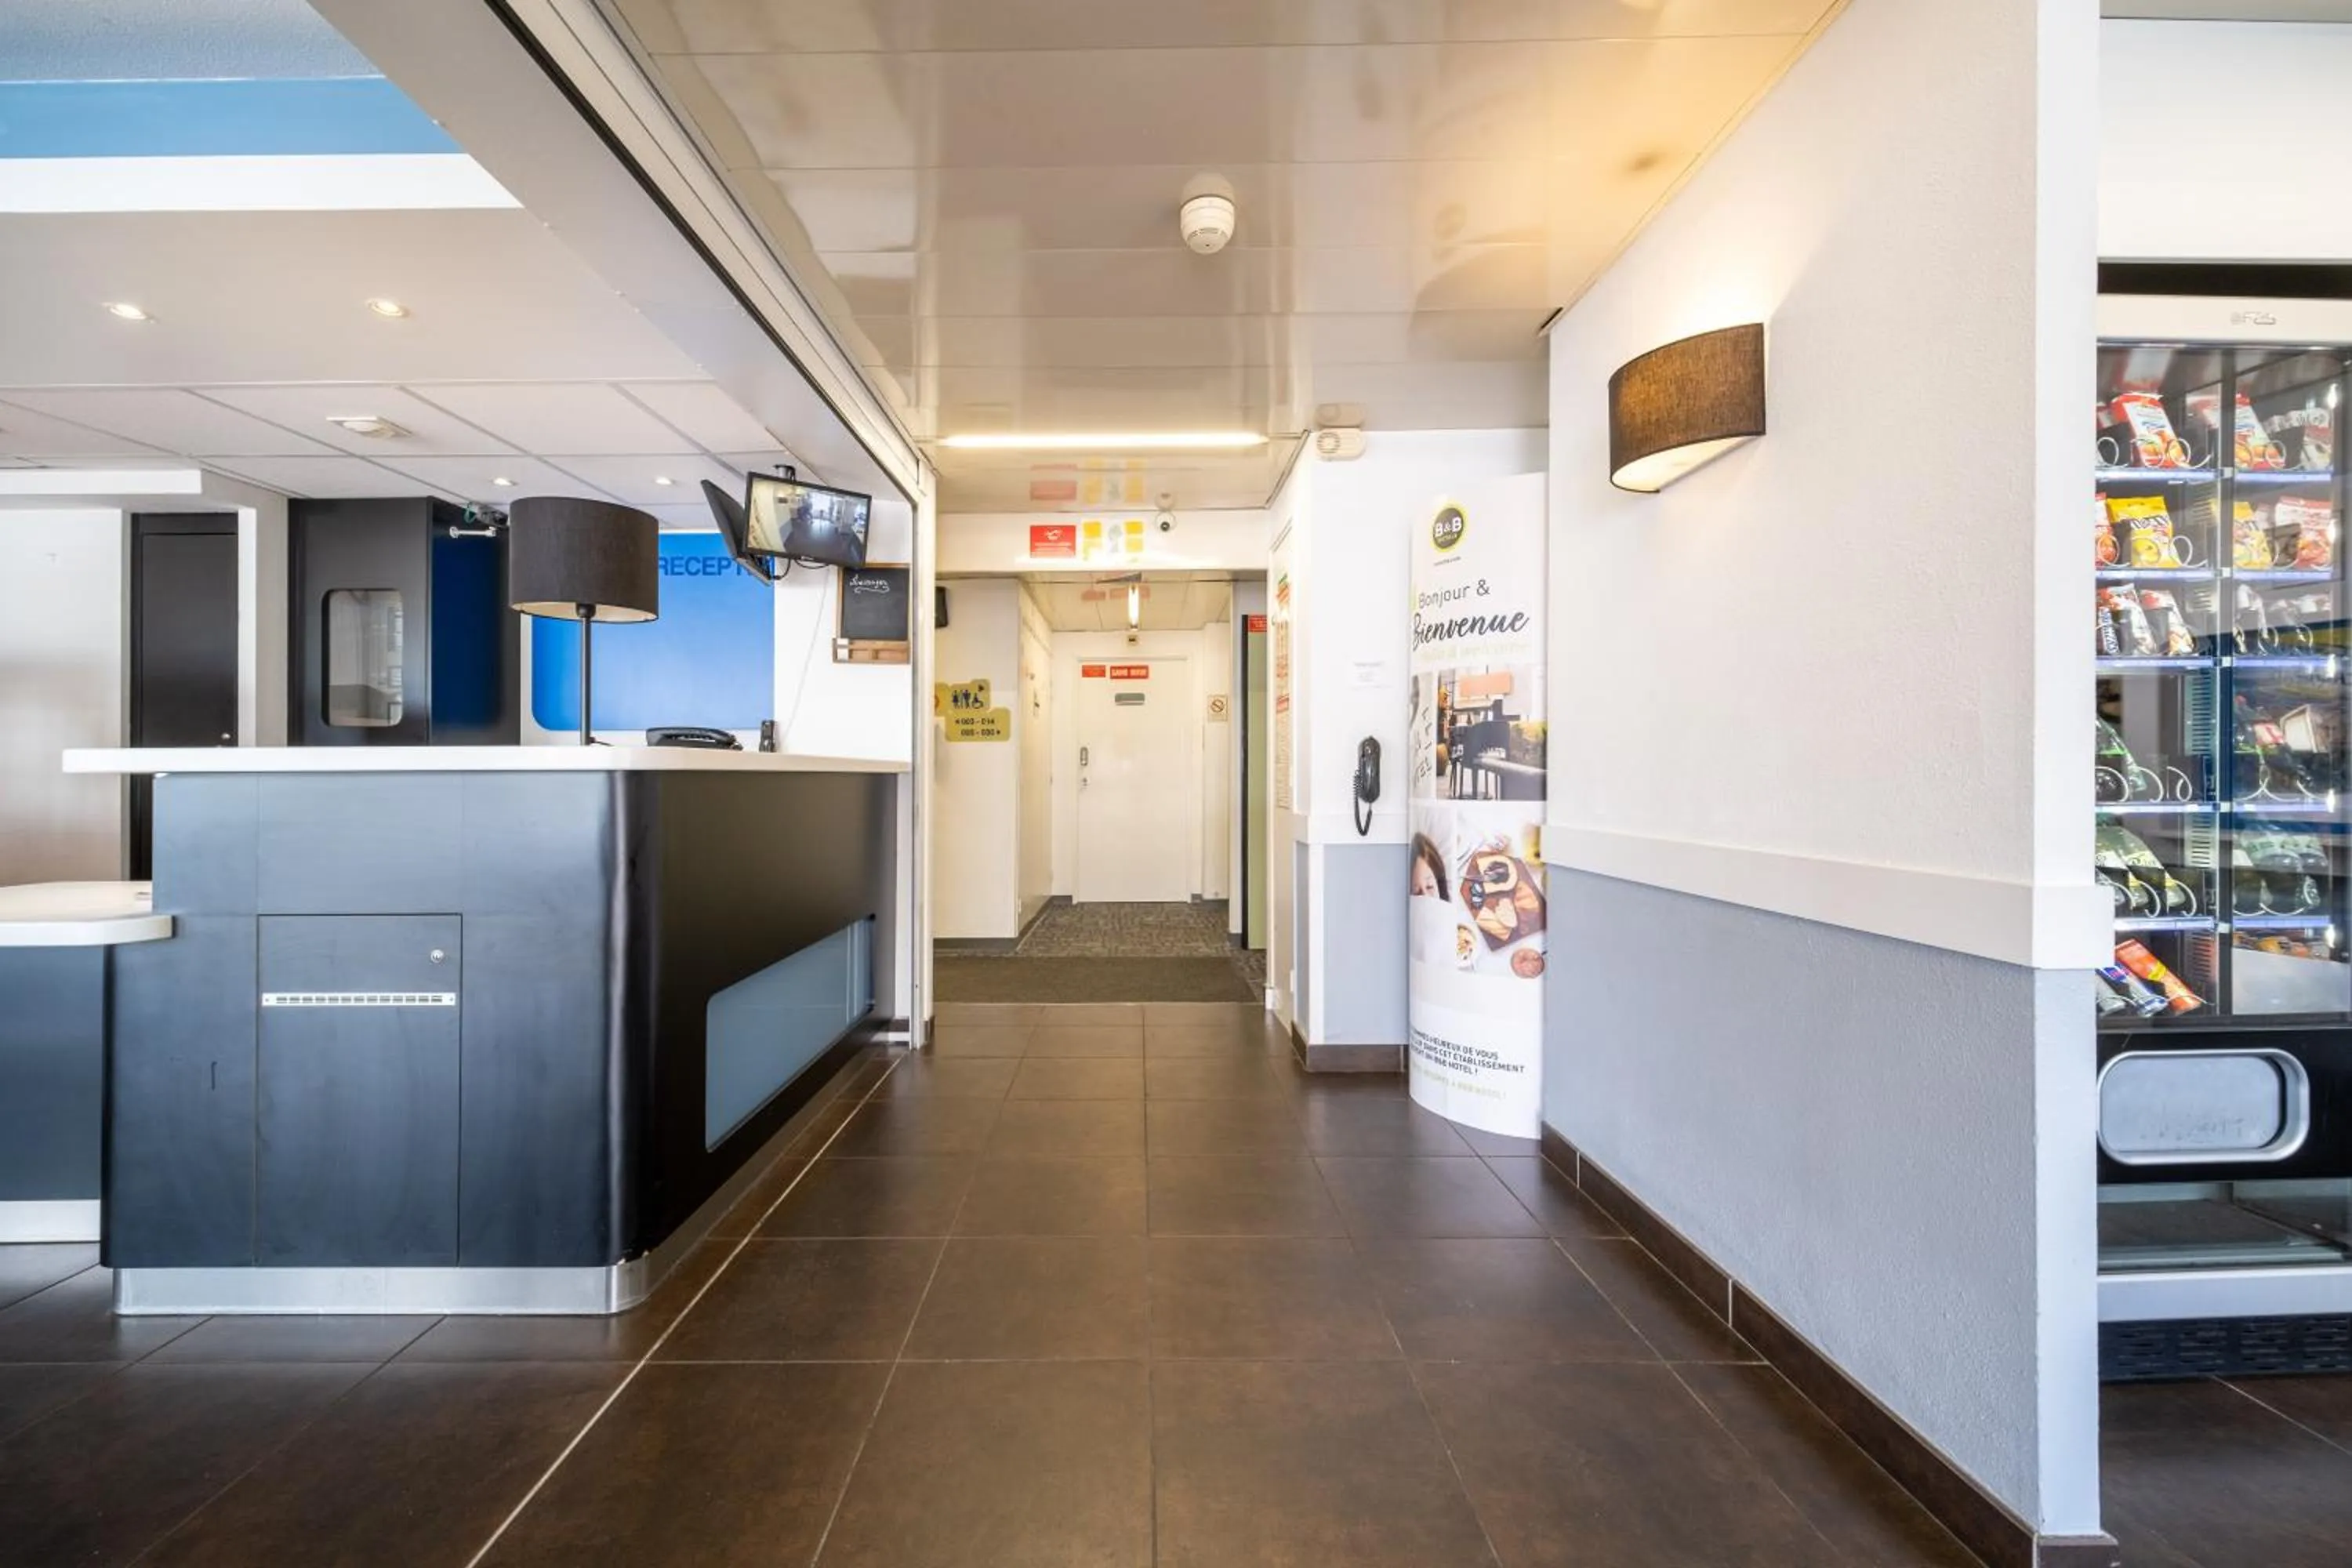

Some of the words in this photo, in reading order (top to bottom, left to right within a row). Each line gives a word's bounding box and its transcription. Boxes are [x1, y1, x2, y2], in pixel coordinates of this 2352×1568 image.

[1434, 517, 1462, 538] B&B
[1418, 586, 1471, 609] Bonjour
[1476, 579, 1490, 596] &
[1412, 612, 1530, 652] Bienvenue
[1462, 1045, 1473, 1056] DE
[1475, 1048, 1499, 1061] VOUS
